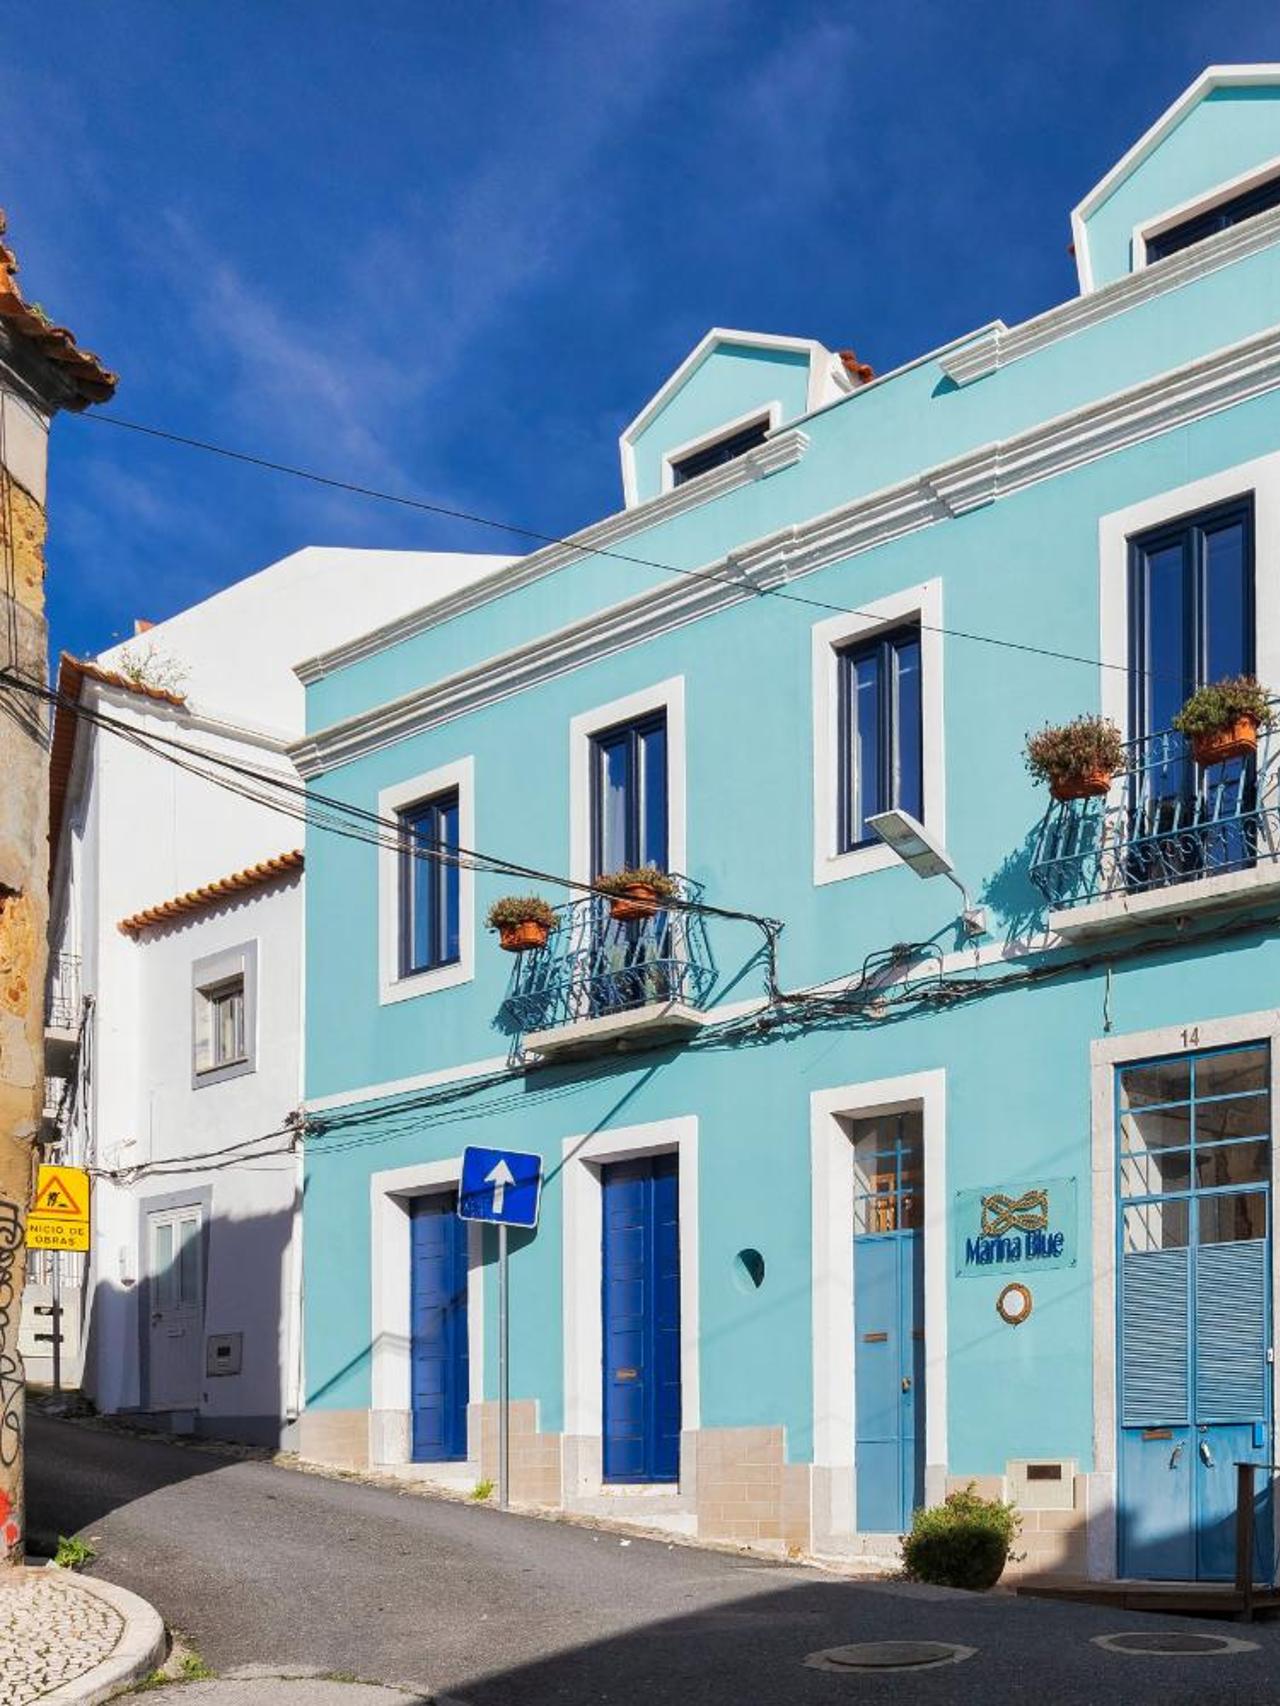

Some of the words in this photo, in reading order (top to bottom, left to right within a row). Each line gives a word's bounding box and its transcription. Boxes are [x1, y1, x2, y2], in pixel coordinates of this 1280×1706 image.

[1180, 1026, 1199, 1048] 14
[69, 1228, 85, 1236] DE
[35, 1235, 75, 1246] OBRAS
[965, 1235, 1021, 1266] Marina
[1025, 1229, 1065, 1260] Blue
